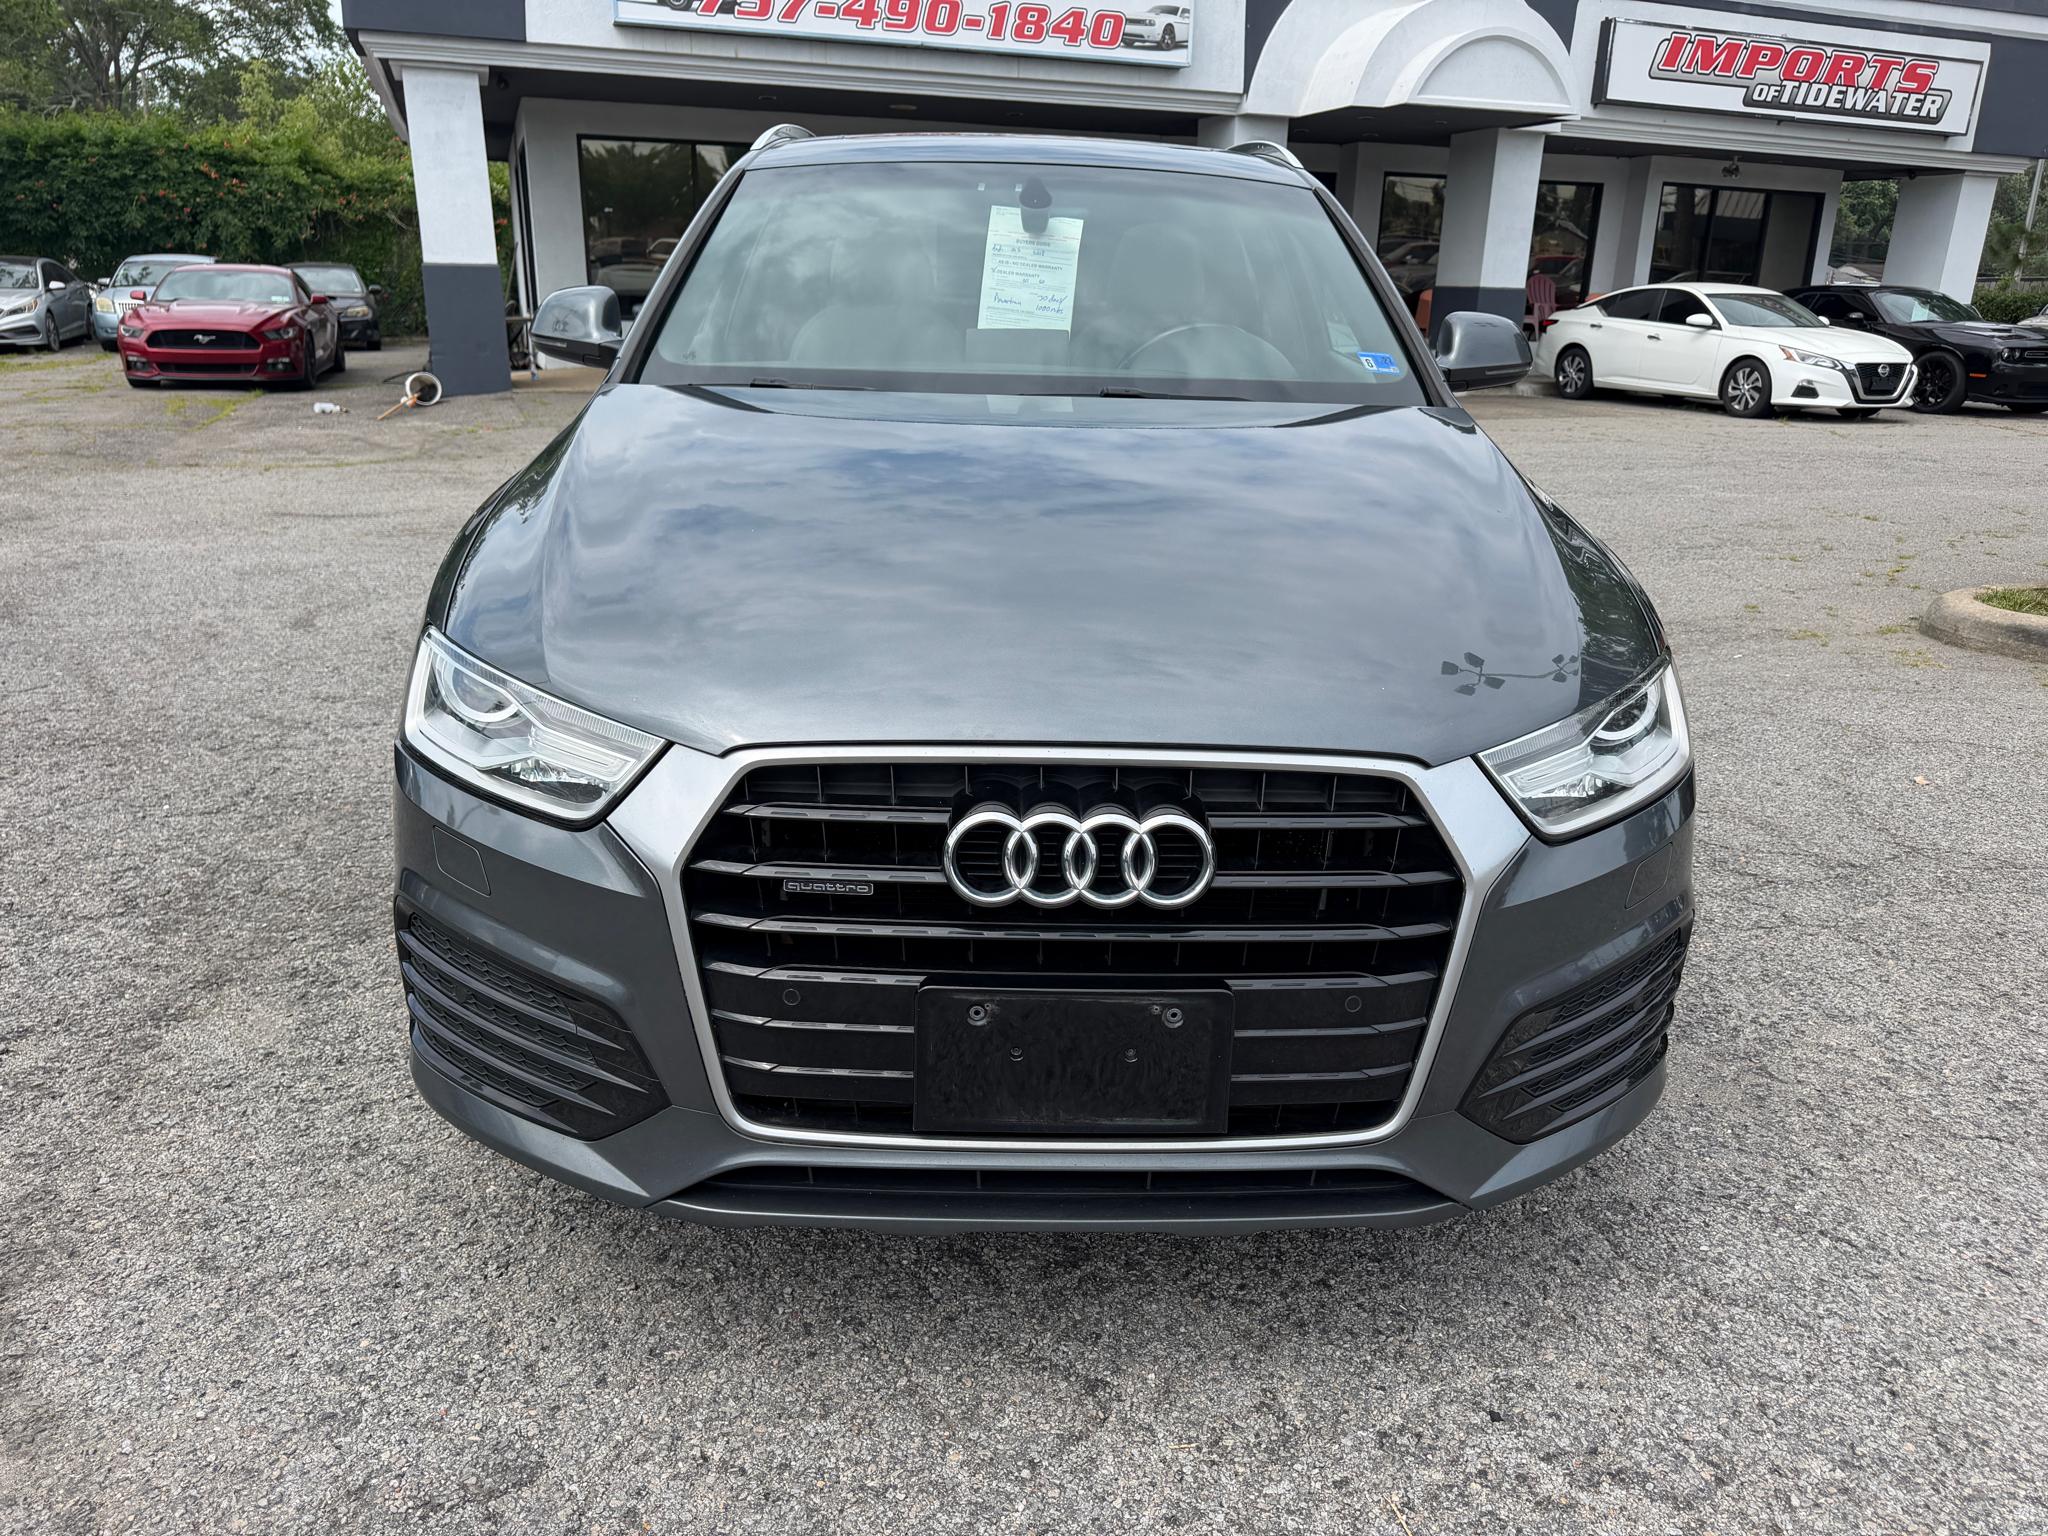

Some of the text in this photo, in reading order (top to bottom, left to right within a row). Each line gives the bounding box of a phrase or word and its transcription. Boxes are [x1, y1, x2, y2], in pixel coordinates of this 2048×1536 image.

[1658, 32, 1939, 94] IMPORTS
[1751, 80, 1944, 119] OF TIDEWATER
[787, 882, 869, 893] quattro
